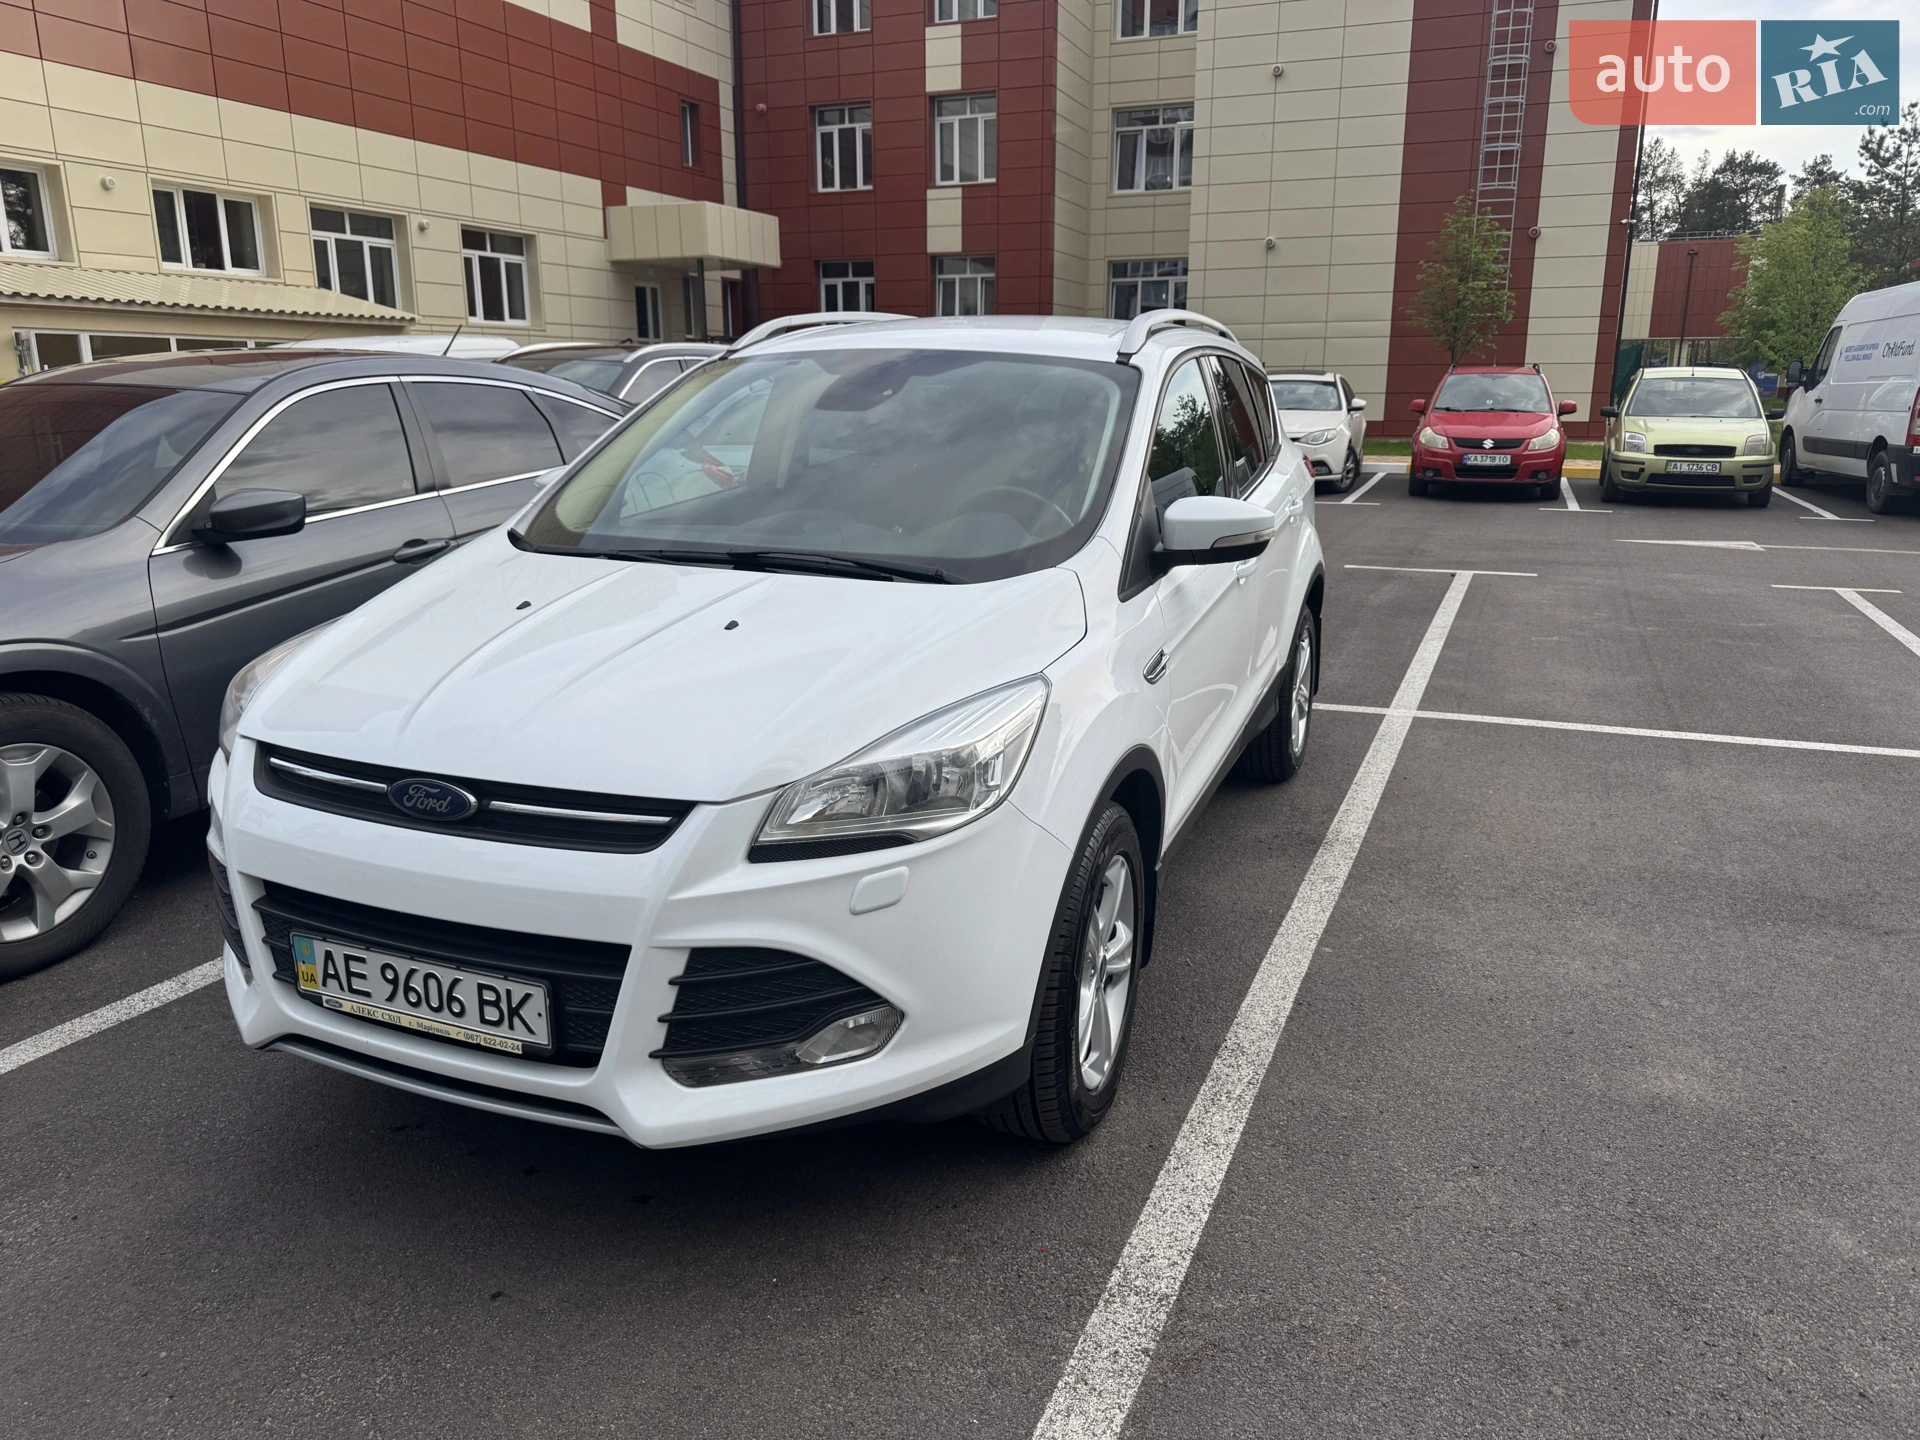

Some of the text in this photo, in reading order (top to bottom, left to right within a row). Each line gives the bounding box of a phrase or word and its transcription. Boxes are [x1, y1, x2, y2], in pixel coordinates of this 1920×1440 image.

[1467, 455, 1478, 463] KA
[1480, 455, 1497, 463] 3718
[1672, 463, 1718, 471] AI 1736 CB
[403, 784, 452, 813] Ford
[301, 970, 317, 985] UA
[321, 948, 538, 1035] AE 9606 BK
[349, 1004, 380, 1019] АЛЕКС
[463, 1031, 483, 1044] (067)
[483, 1036, 521, 1052] 622-02-24
